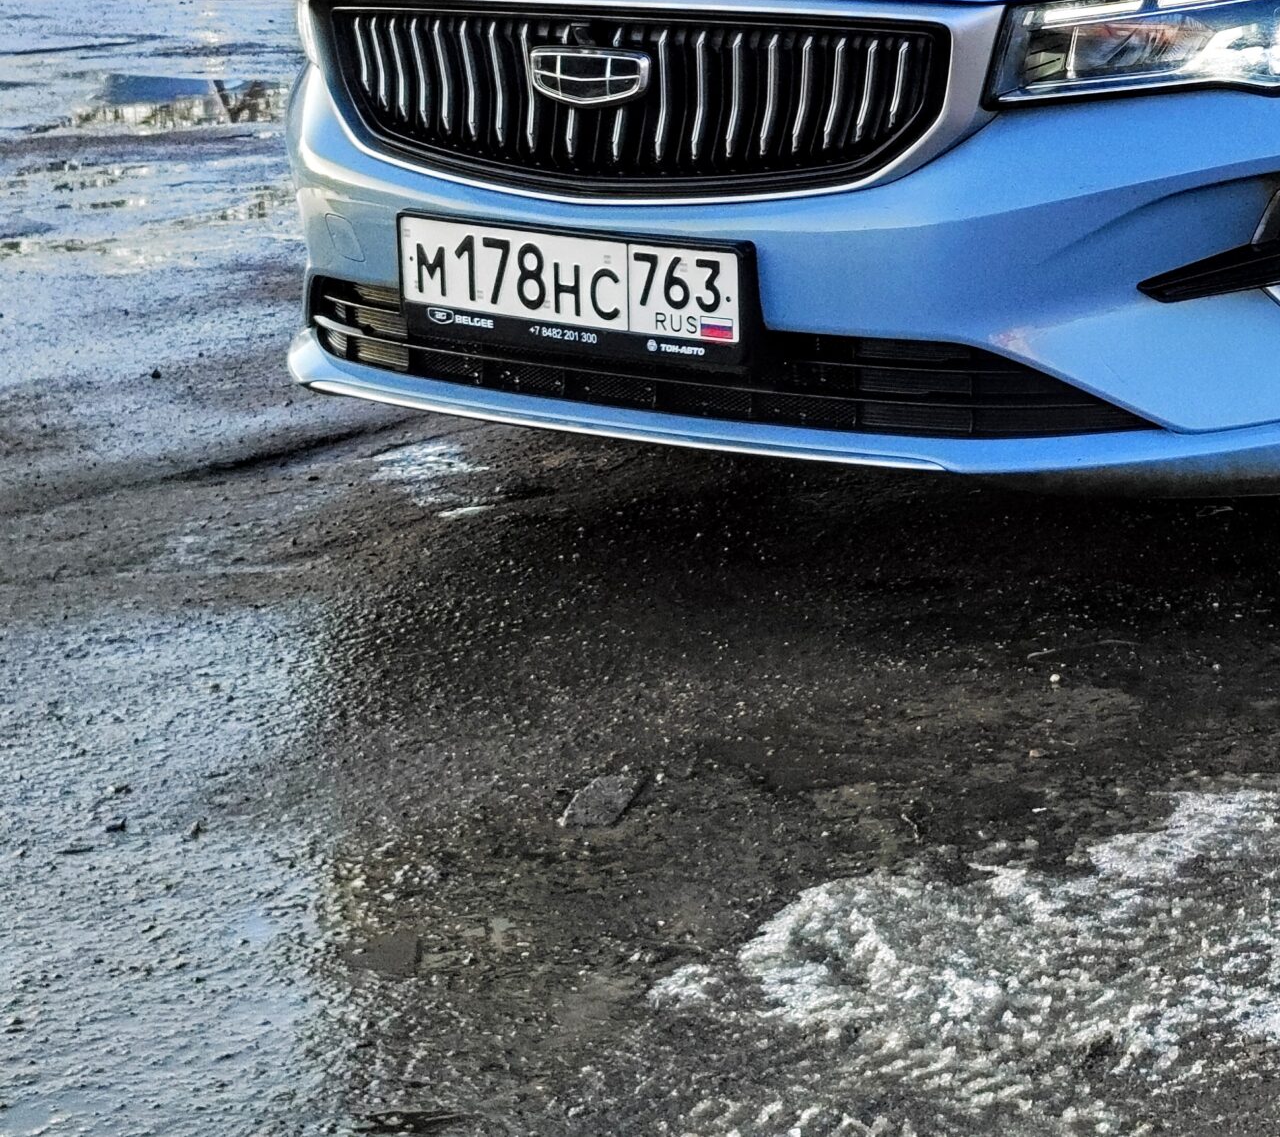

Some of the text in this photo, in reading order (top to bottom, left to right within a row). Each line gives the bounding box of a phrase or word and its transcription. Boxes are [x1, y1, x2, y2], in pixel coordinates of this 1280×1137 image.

[633, 252, 721, 312] 763
[454, 314, 495, 329] BELGEE
[654, 312, 698, 334] RUS
[529, 325, 598, 344] +7 8482 201 300
